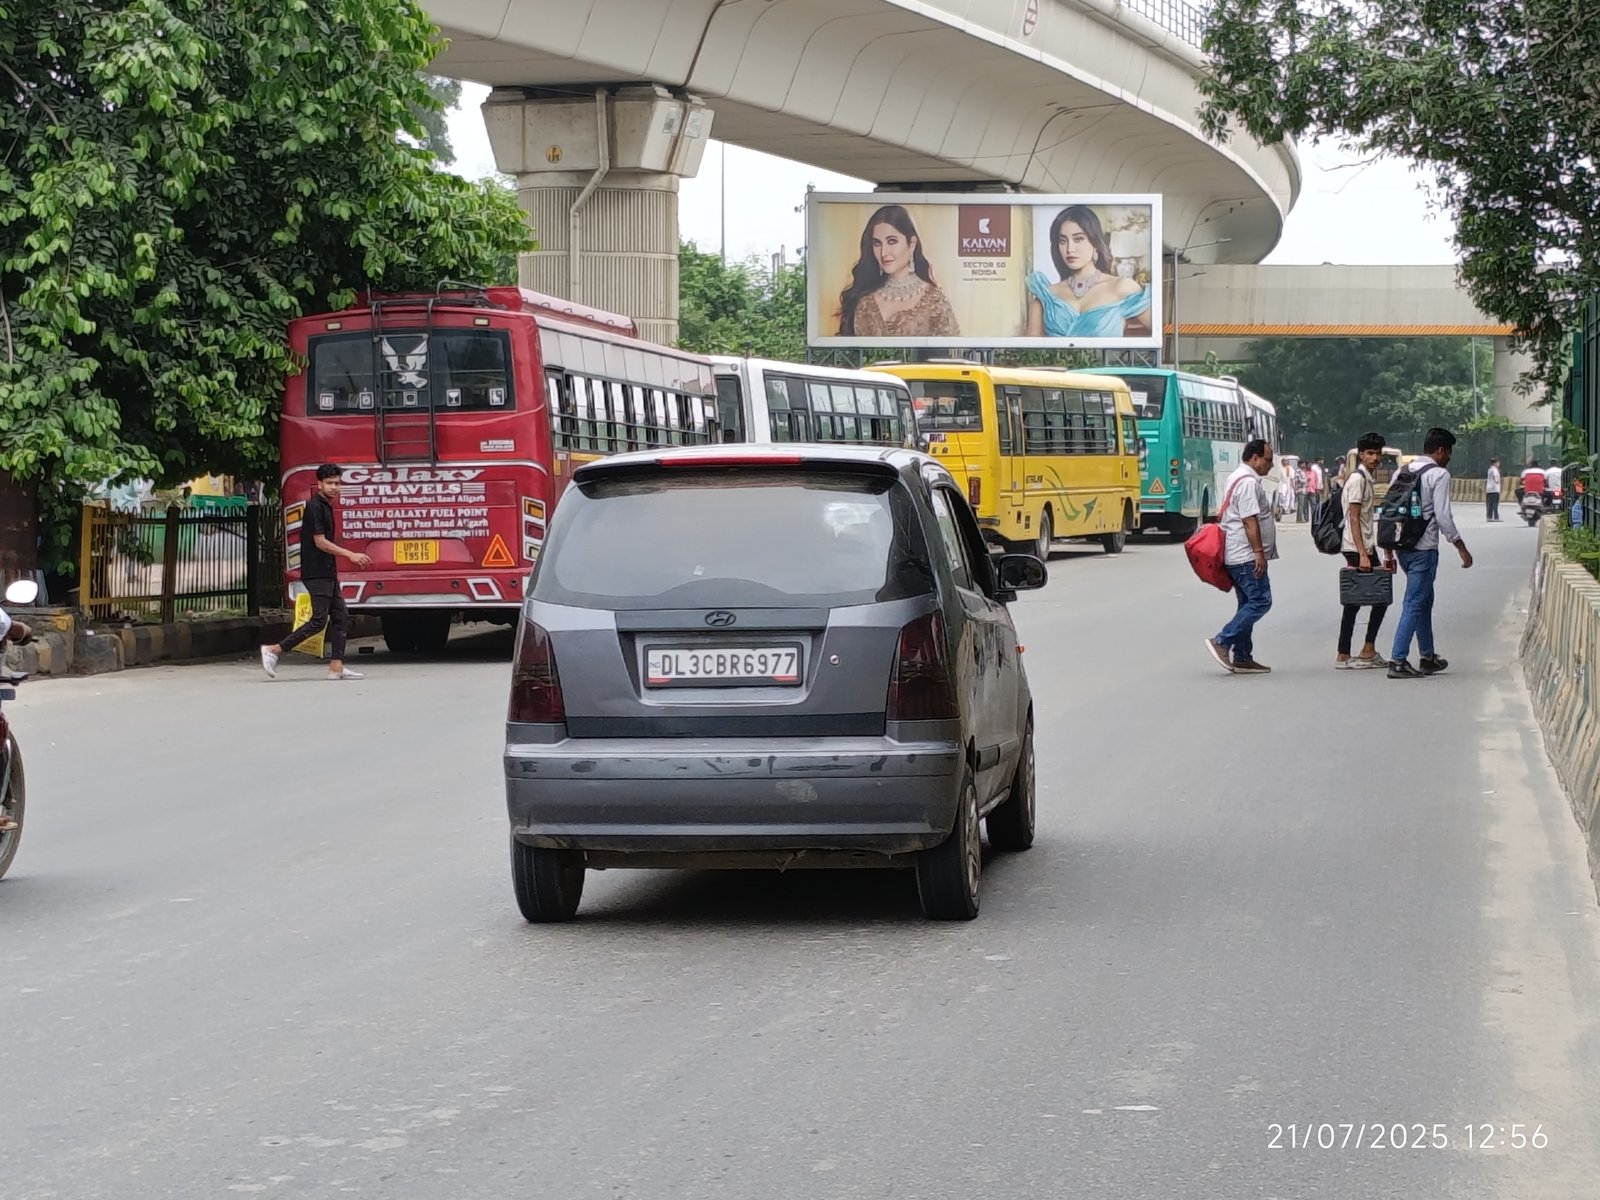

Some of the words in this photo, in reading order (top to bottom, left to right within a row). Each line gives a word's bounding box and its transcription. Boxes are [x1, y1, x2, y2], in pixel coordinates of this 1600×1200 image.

[962, 238, 1007, 248] KALYAN
[340, 468, 486, 484] Galaxy
[364, 483, 462, 496] TRAVELS
[340, 497, 357, 505] Opp.
[382, 496, 401, 504] Bank
[457, 494, 486, 504] Aligarh
[342, 510, 385, 519] SHAKUN
[387, 509, 427, 518] GALAXY
[430, 508, 455, 517] FUEL
[458, 508, 488, 517] POINT
[661, 652, 796, 676] DL3CBR6977
